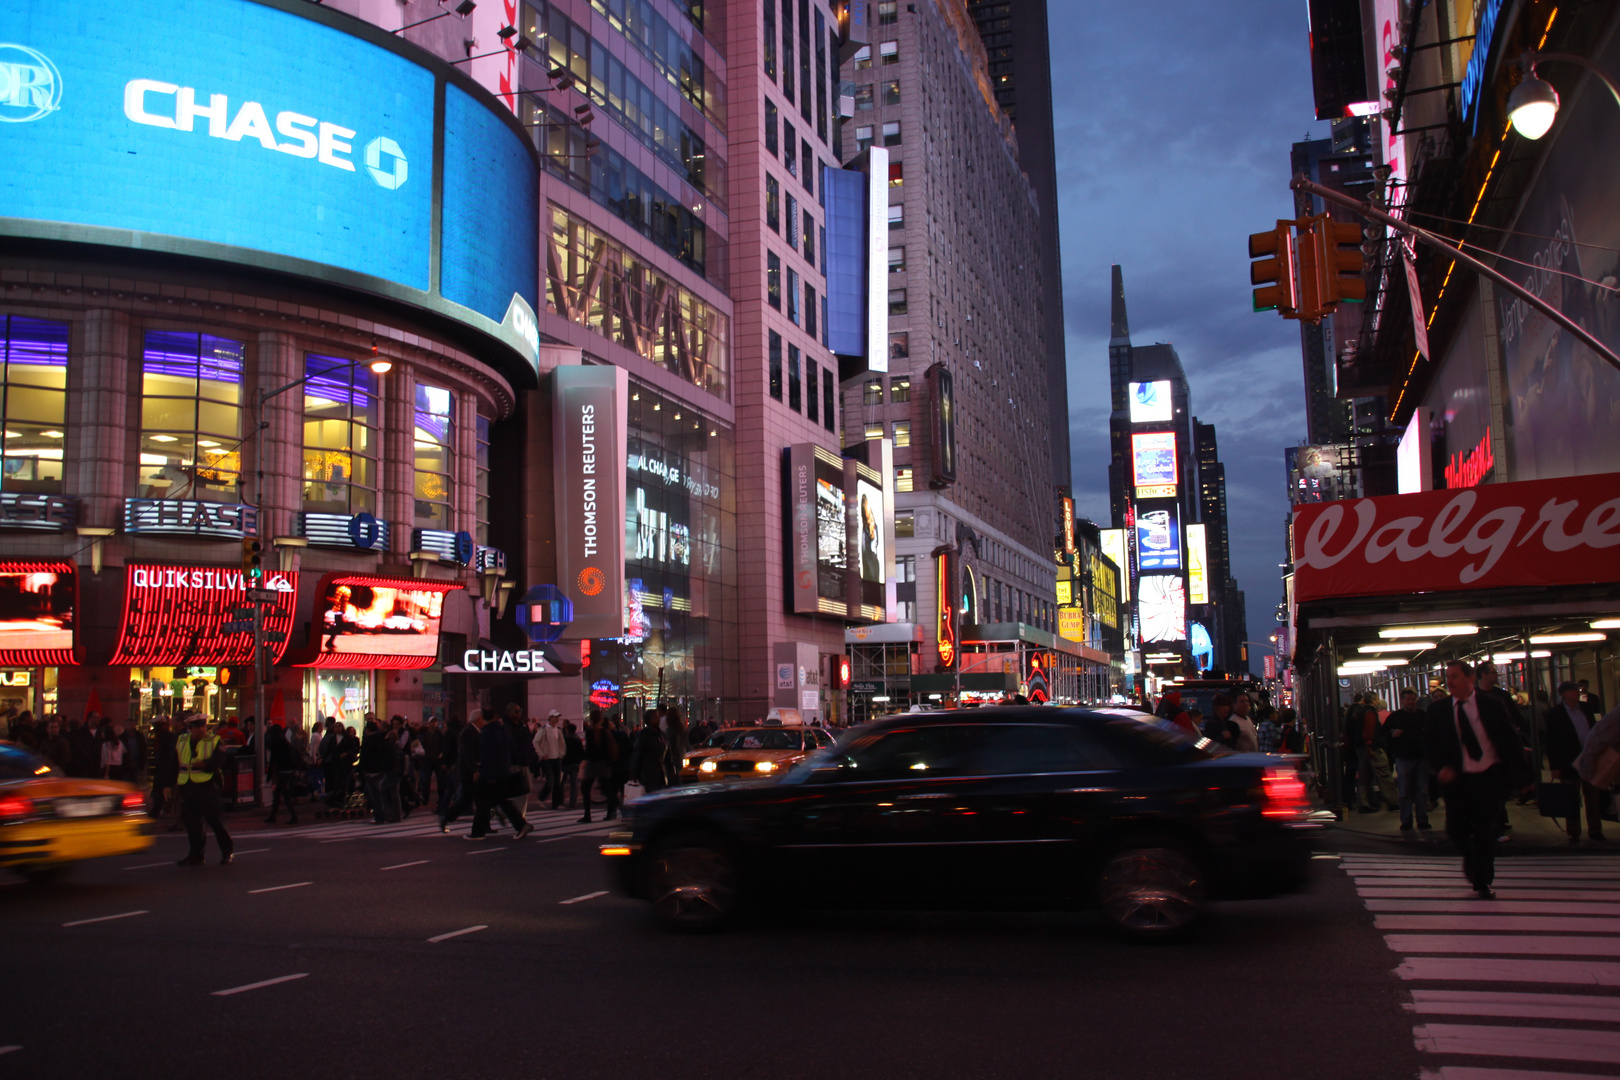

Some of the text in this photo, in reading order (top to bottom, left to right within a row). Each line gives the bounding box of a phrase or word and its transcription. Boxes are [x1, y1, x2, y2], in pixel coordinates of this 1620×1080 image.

[124, 79, 357, 172] CHASE
[581, 404, 597, 558] THOMSON REUTERS
[1137, 487, 1161, 496] HSBC
[129, 501, 257, 532] CHASE
[799, 465, 809, 564] THOMSON REUTERS
[134, 569, 256, 591] QUIKSILV
[1059, 611, 1081, 620] BUBBA
[464, 649, 545, 672] CHASE
